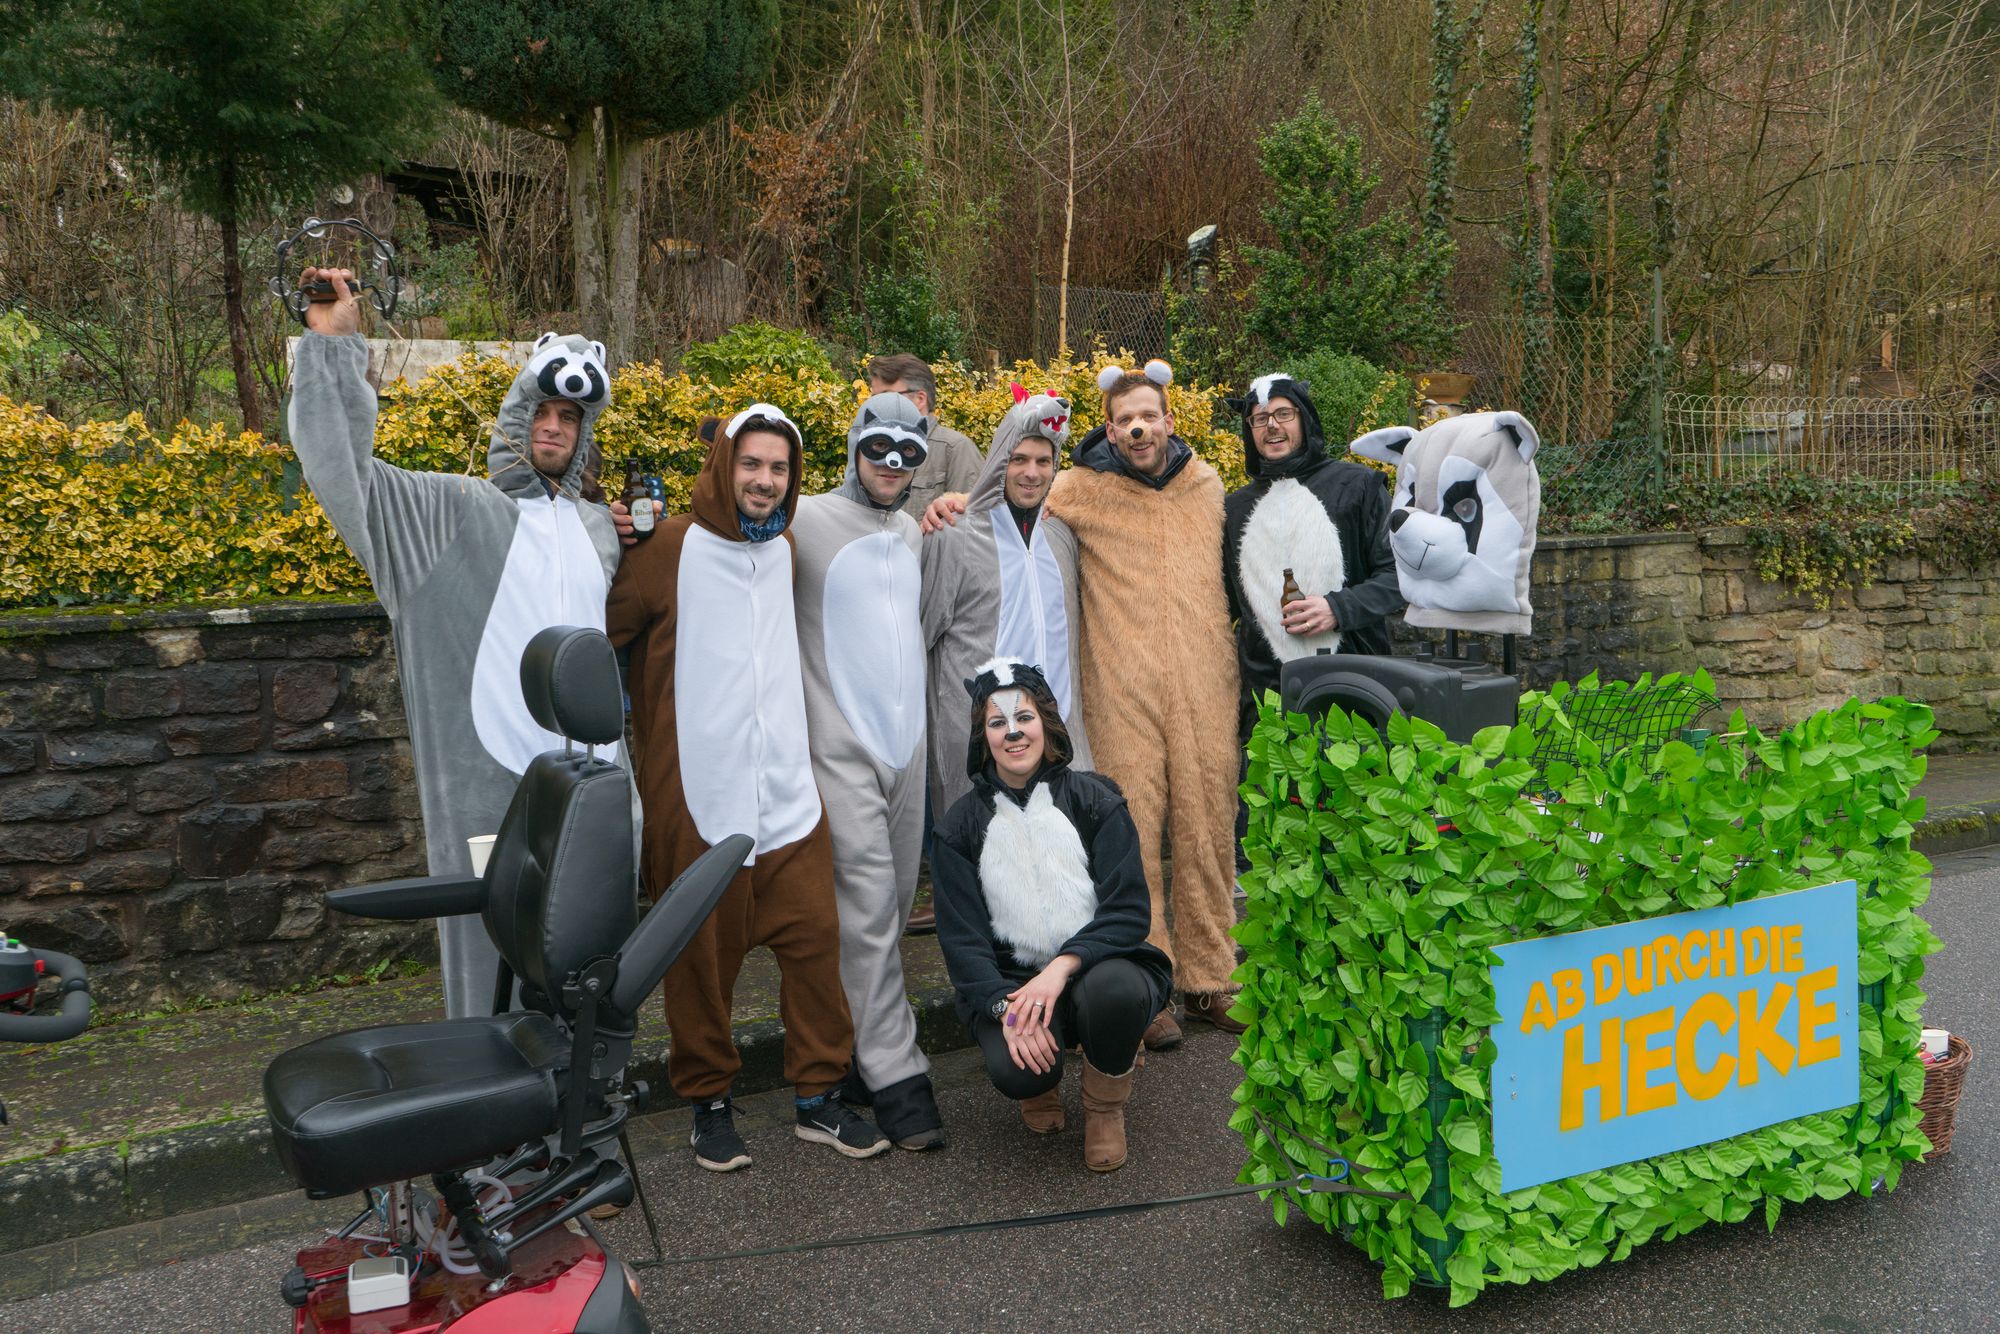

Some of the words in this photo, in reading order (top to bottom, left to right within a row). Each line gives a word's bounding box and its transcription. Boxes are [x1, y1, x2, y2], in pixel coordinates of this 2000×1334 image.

[1520, 968, 1585, 1033] AB
[1592, 928, 1736, 1005] DURCH
[1742, 924, 1804, 975] DIE
[1560, 966, 1841, 1132] HECKE
